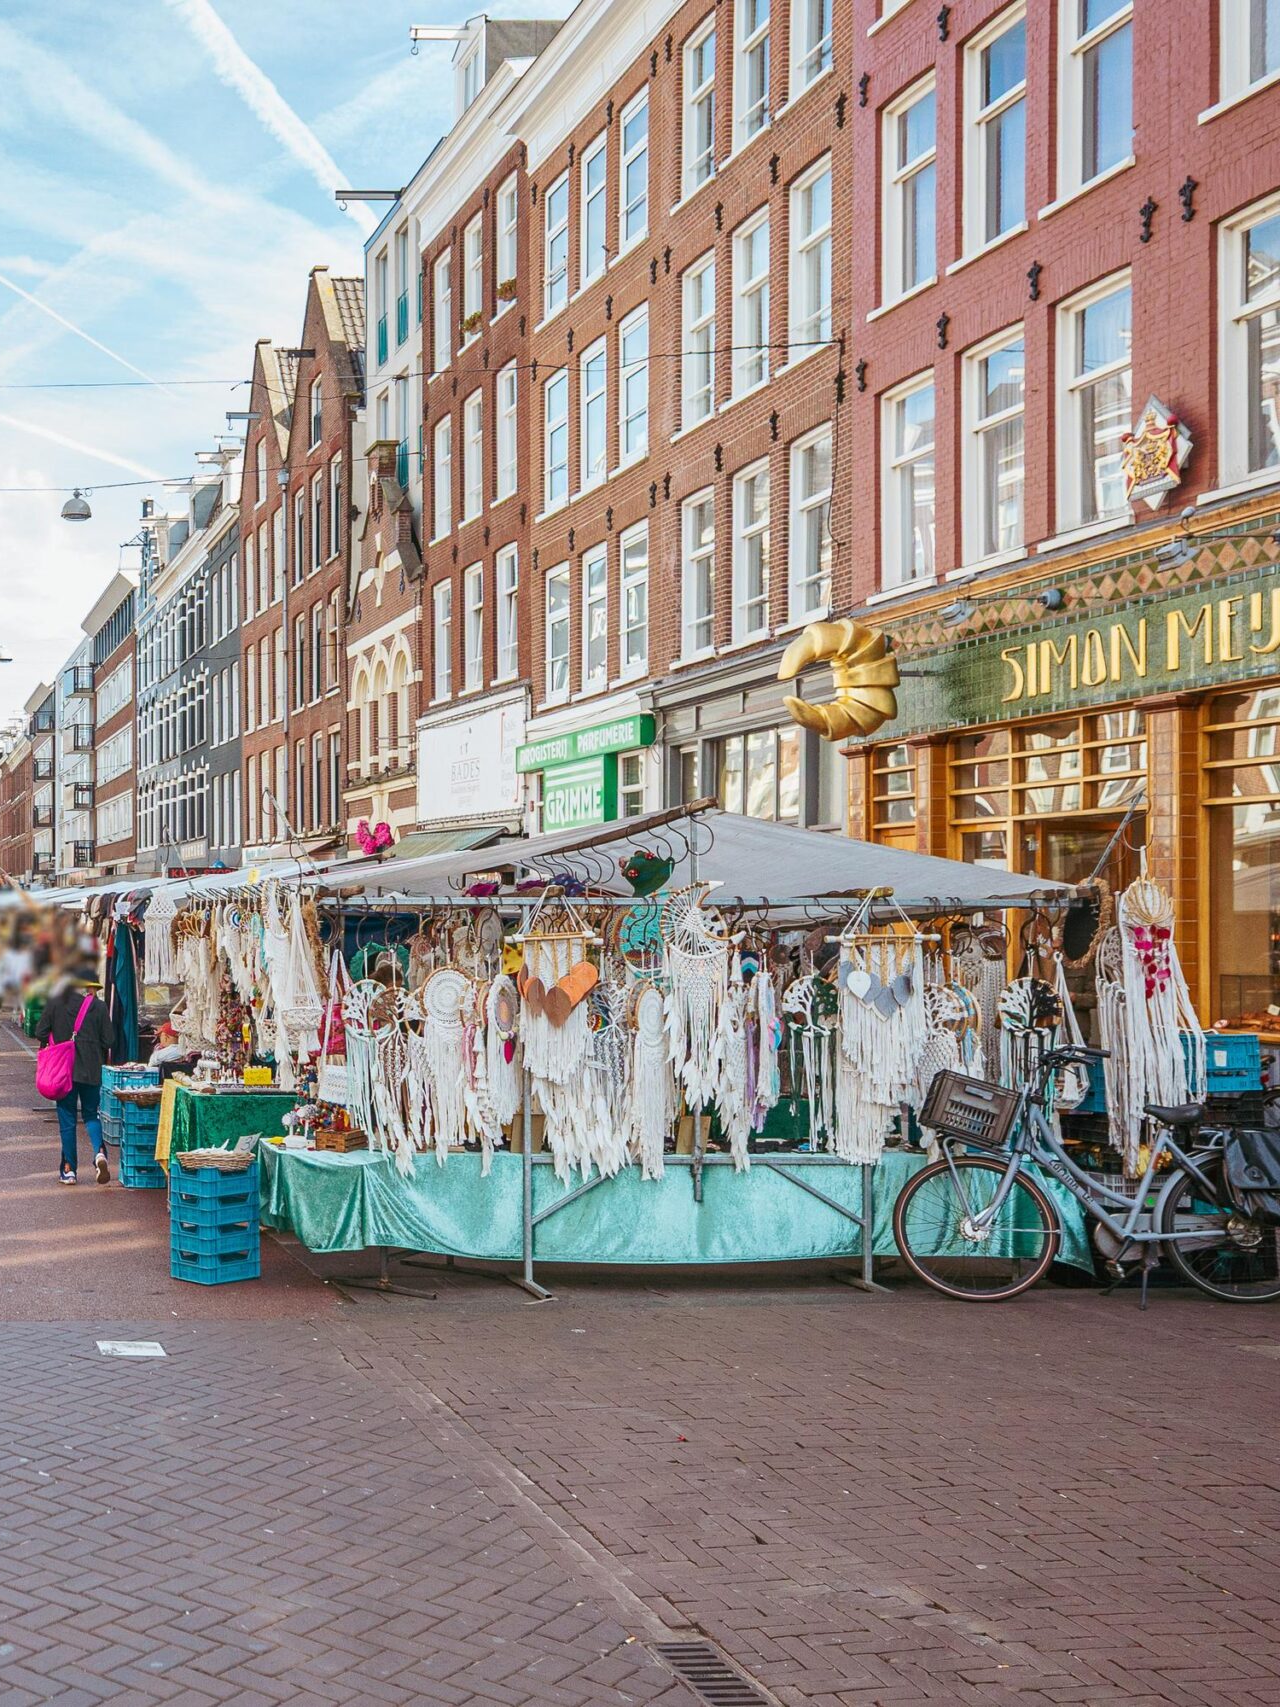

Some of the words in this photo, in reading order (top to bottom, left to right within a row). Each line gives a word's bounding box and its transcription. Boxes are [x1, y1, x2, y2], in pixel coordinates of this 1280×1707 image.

[1001, 618, 1147, 703] SIMON
[577, 721, 635, 753] PARFUMERIE
[546, 783, 602, 826] GRIMME
